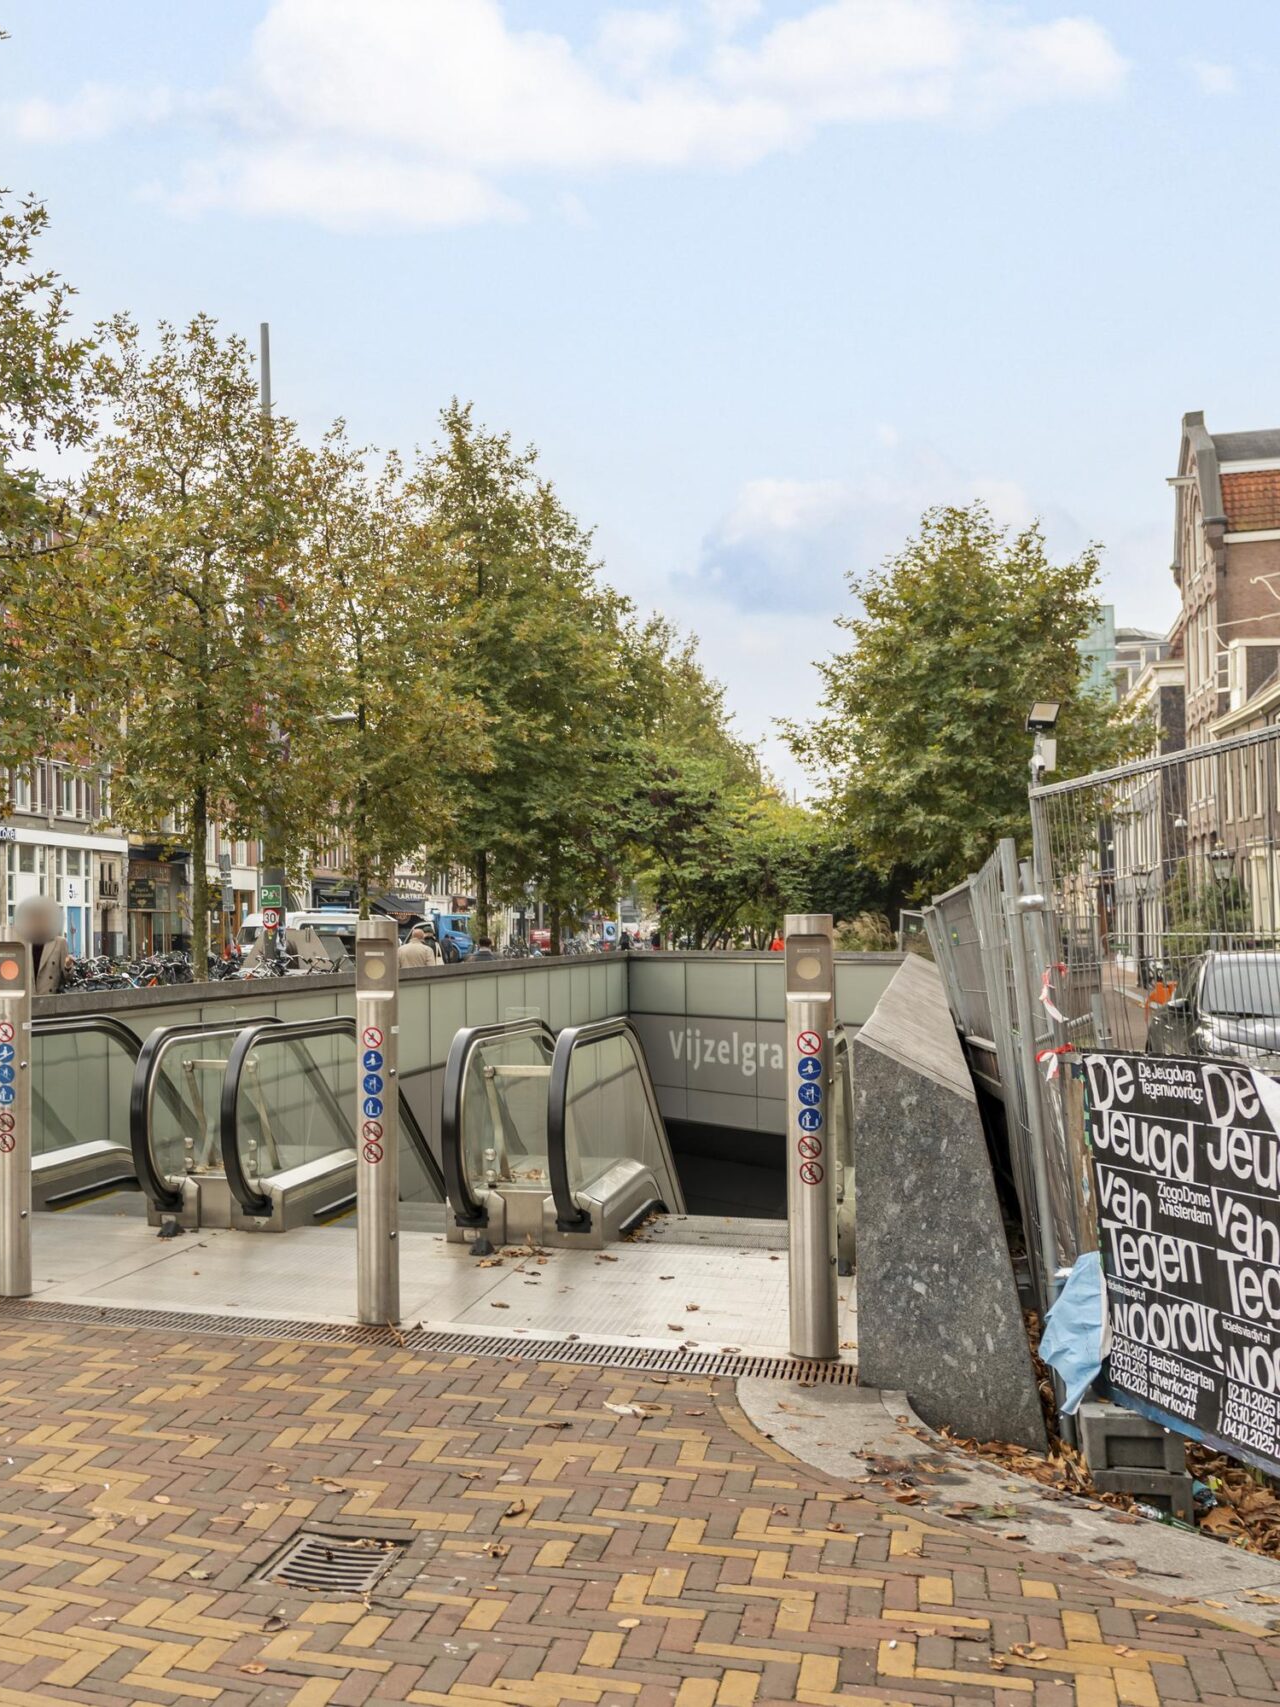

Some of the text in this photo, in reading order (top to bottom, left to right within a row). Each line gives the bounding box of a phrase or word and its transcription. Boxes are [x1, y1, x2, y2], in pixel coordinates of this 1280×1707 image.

[261, 889, 269, 899] P
[264, 912, 276, 923] 30
[669, 1028, 784, 1076] Vijzelgra
[1083, 1053, 1135, 1110] De
[1201, 1064, 1260, 1127] De
[1092, 1109, 1194, 1183] Jeugd
[1207, 1127, 1280, 1190] Jeu
[1159, 1199, 1213, 1226] Amsterdam
[1102, 1218, 1202, 1293] Tegen
[1225, 1402, 1276, 1436] 03.10.2025
[1227, 1381, 1276, 1417] 02.10.2025
[1223, 1420, 1275, 1454] 04.10.2025
